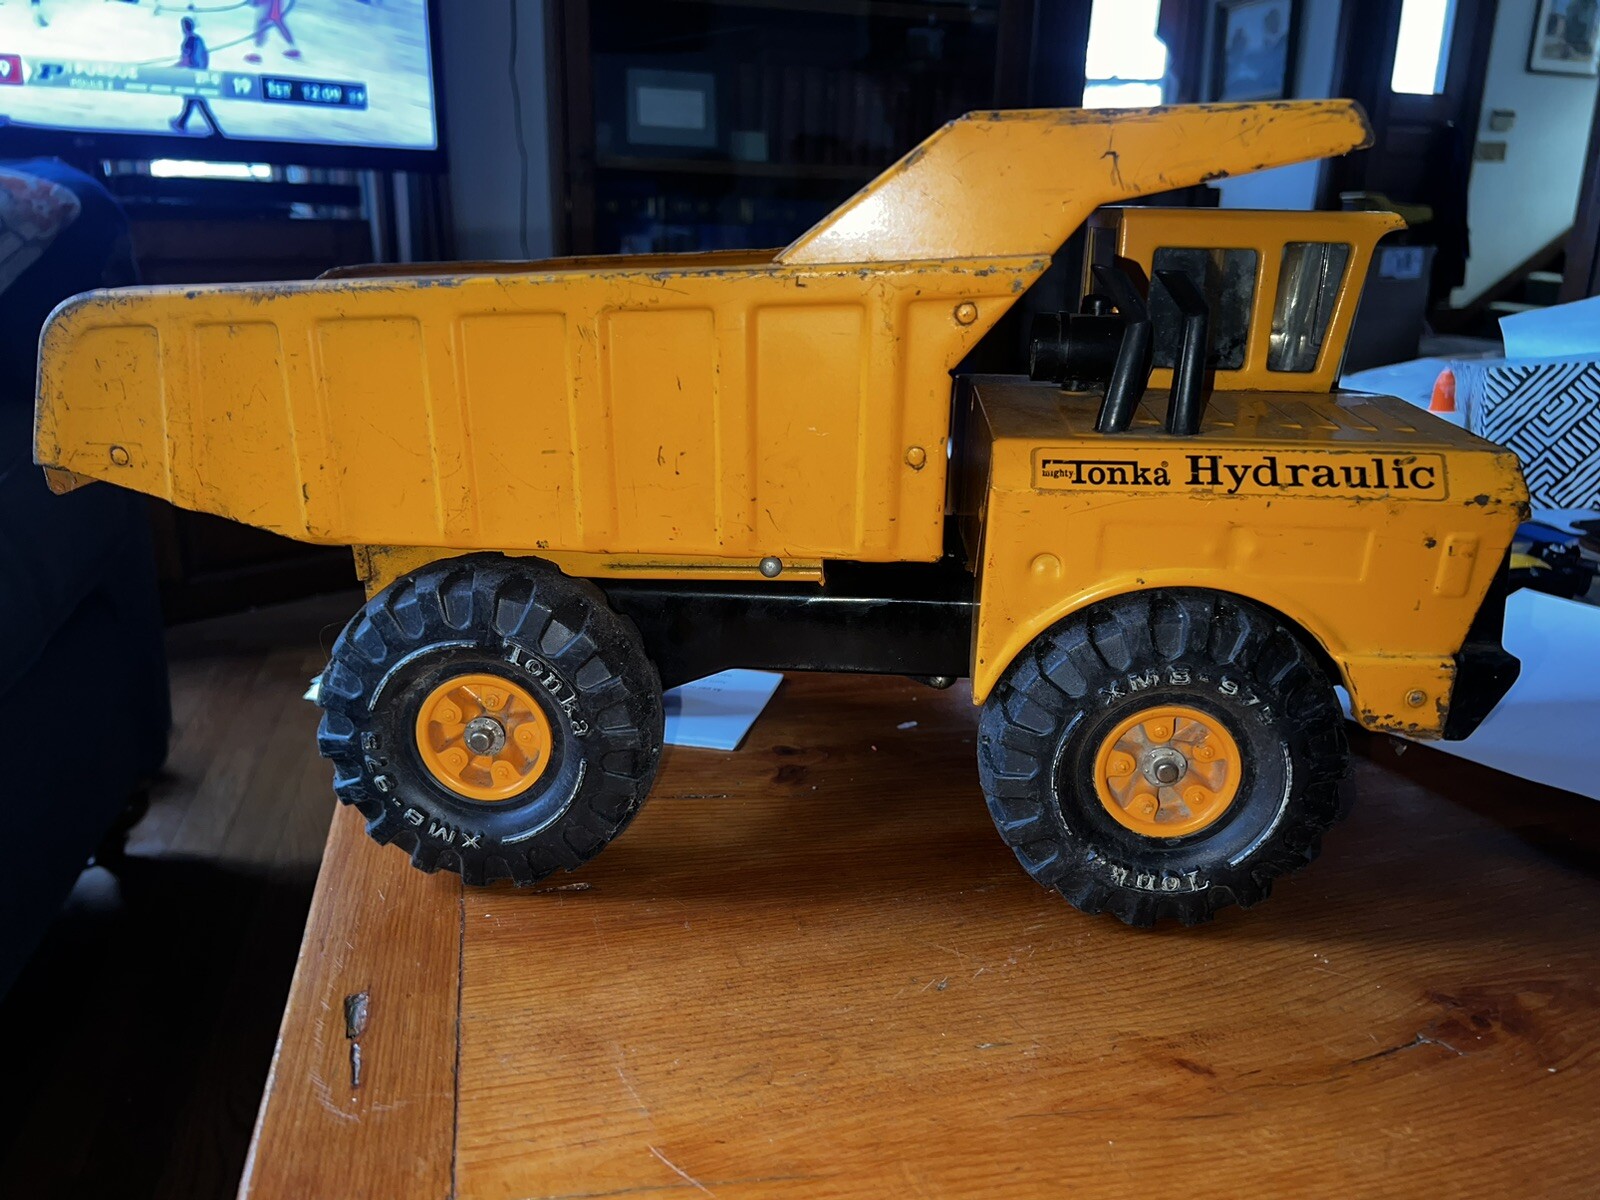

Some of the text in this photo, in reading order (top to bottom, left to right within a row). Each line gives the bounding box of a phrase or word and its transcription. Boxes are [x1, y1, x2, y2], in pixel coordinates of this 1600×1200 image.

[1042, 469, 1074, 479] mighty
[1042, 455, 1436, 494] Tonka Hydraulic
[502, 637, 589, 738] Tonka
